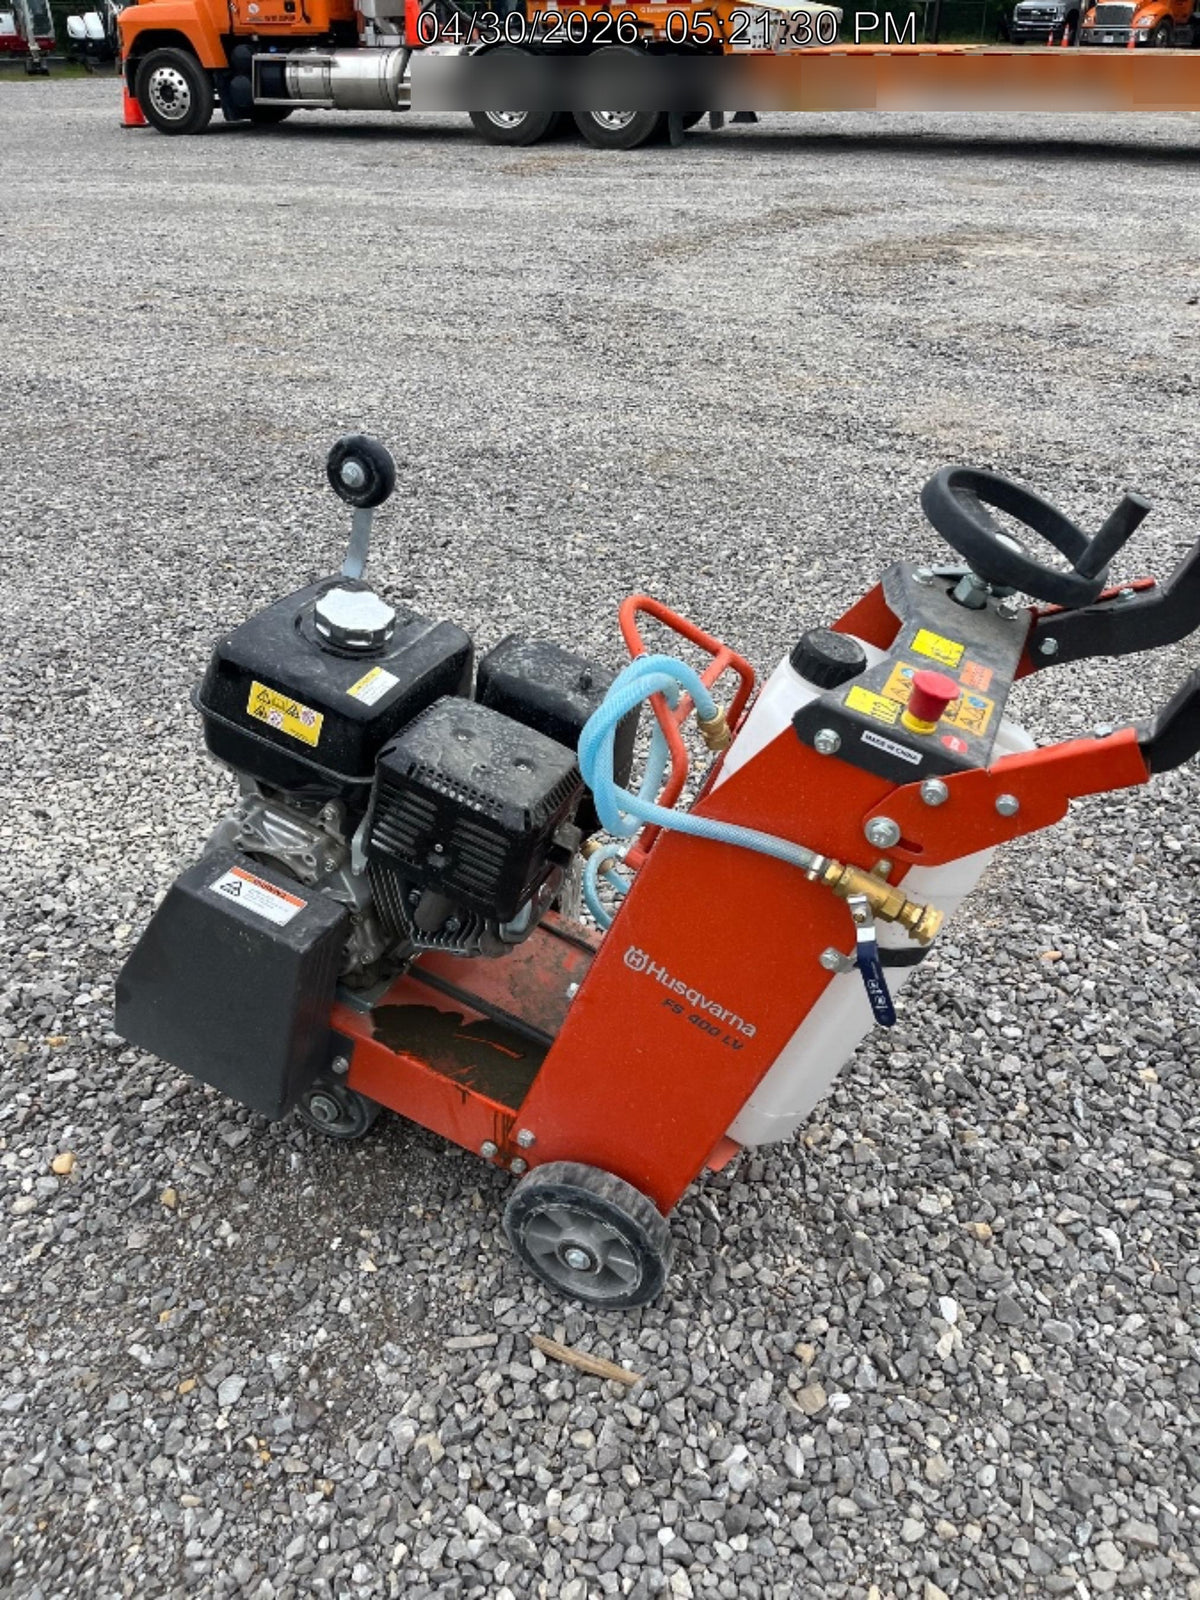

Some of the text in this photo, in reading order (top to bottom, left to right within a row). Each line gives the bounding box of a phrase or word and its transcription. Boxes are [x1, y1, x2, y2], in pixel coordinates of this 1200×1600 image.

[645, 961, 757, 1038] Husqvarna
[661, 998, 745, 1051] FS 400 LV
